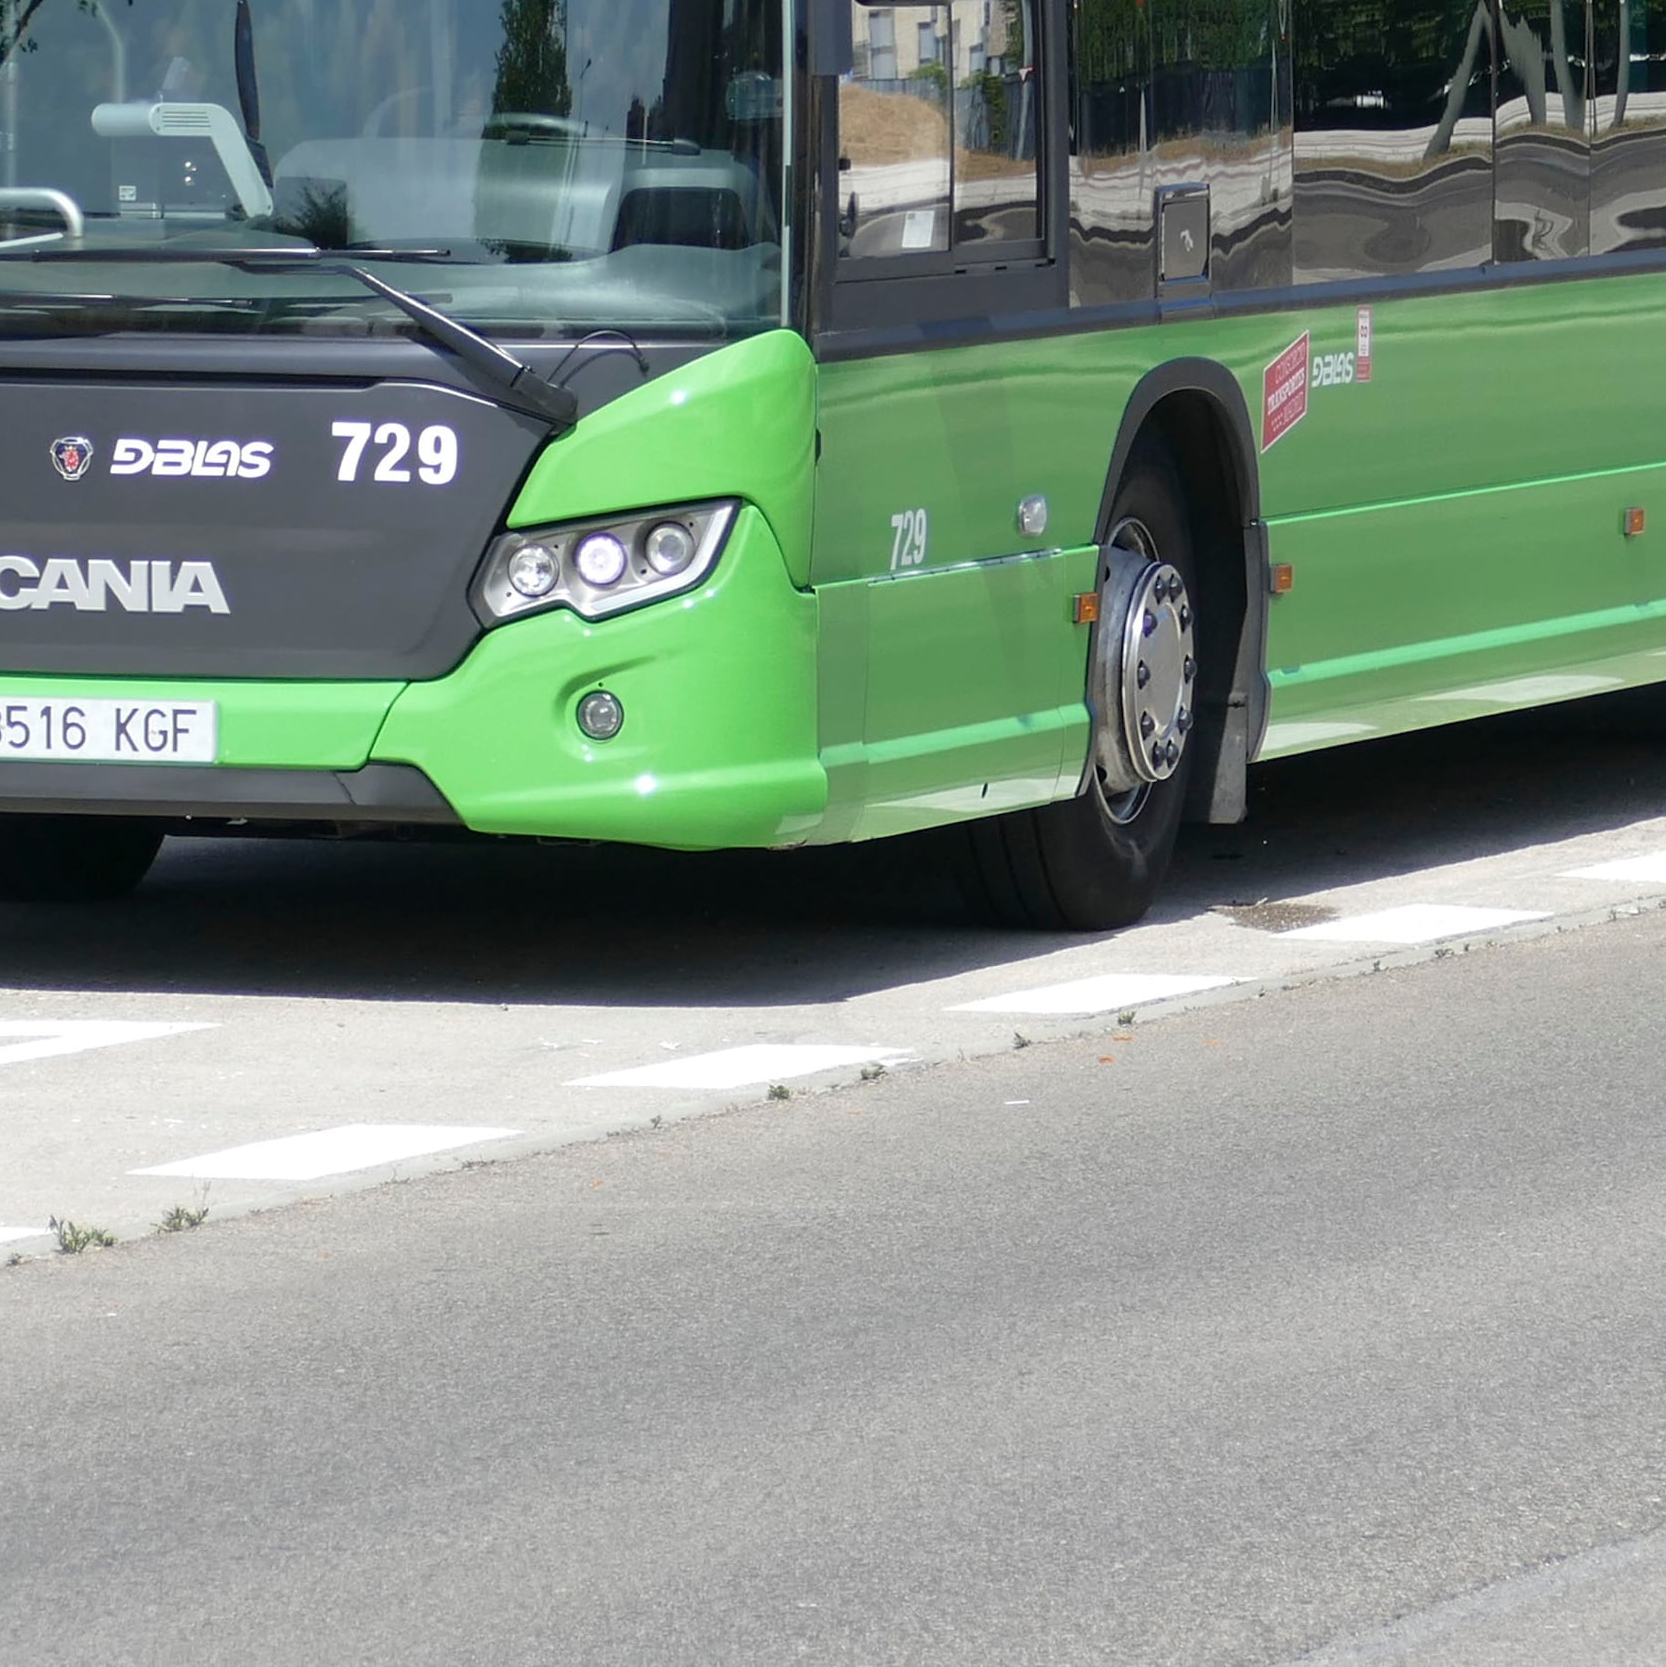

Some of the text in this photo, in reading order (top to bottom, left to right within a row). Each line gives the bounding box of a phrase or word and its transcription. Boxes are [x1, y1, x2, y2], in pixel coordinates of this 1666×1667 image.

[331, 421, 459, 485] 729
[890, 507, 927, 571] 729
[115, 707, 198, 753] KGF
